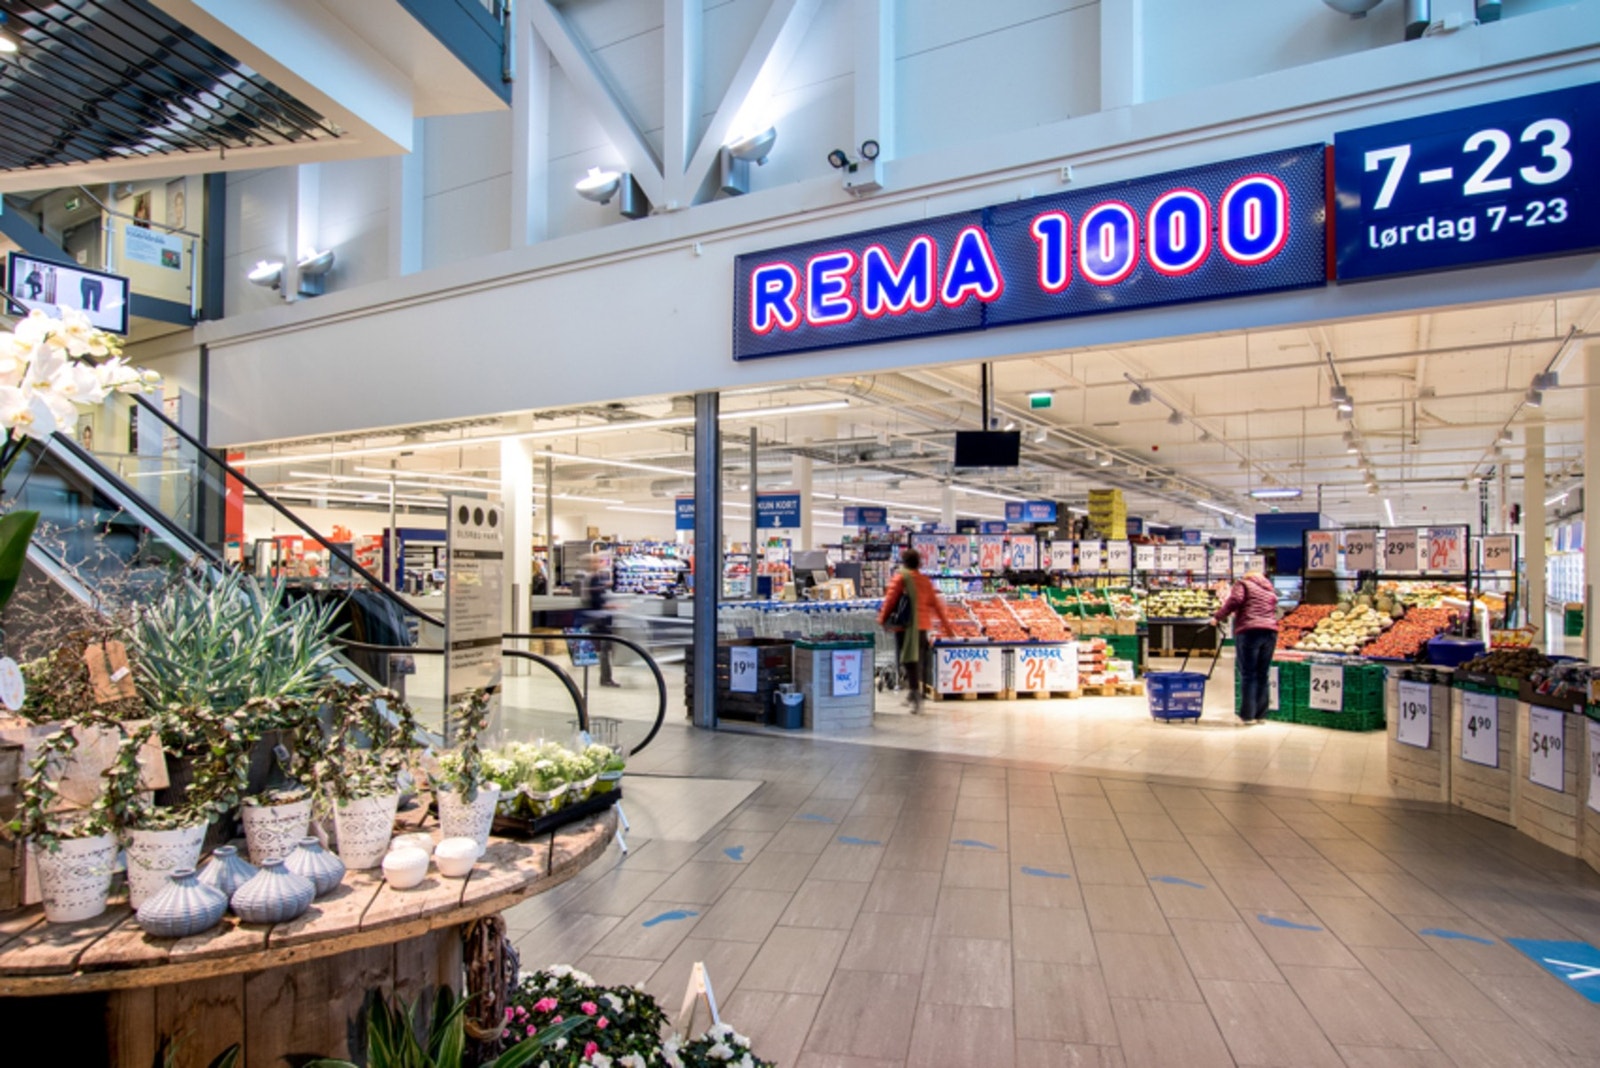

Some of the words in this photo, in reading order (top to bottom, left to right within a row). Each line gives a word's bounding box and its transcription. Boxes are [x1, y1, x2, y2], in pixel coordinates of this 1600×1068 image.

[1364, 118, 1573, 210] 7-23
[751, 225, 1003, 335] REMA
[1030, 173, 1290, 292] 1000
[1369, 216, 1477, 249] lørdag
[1486, 198, 1569, 233] 7-23
[775, 500, 797, 509] KORT
